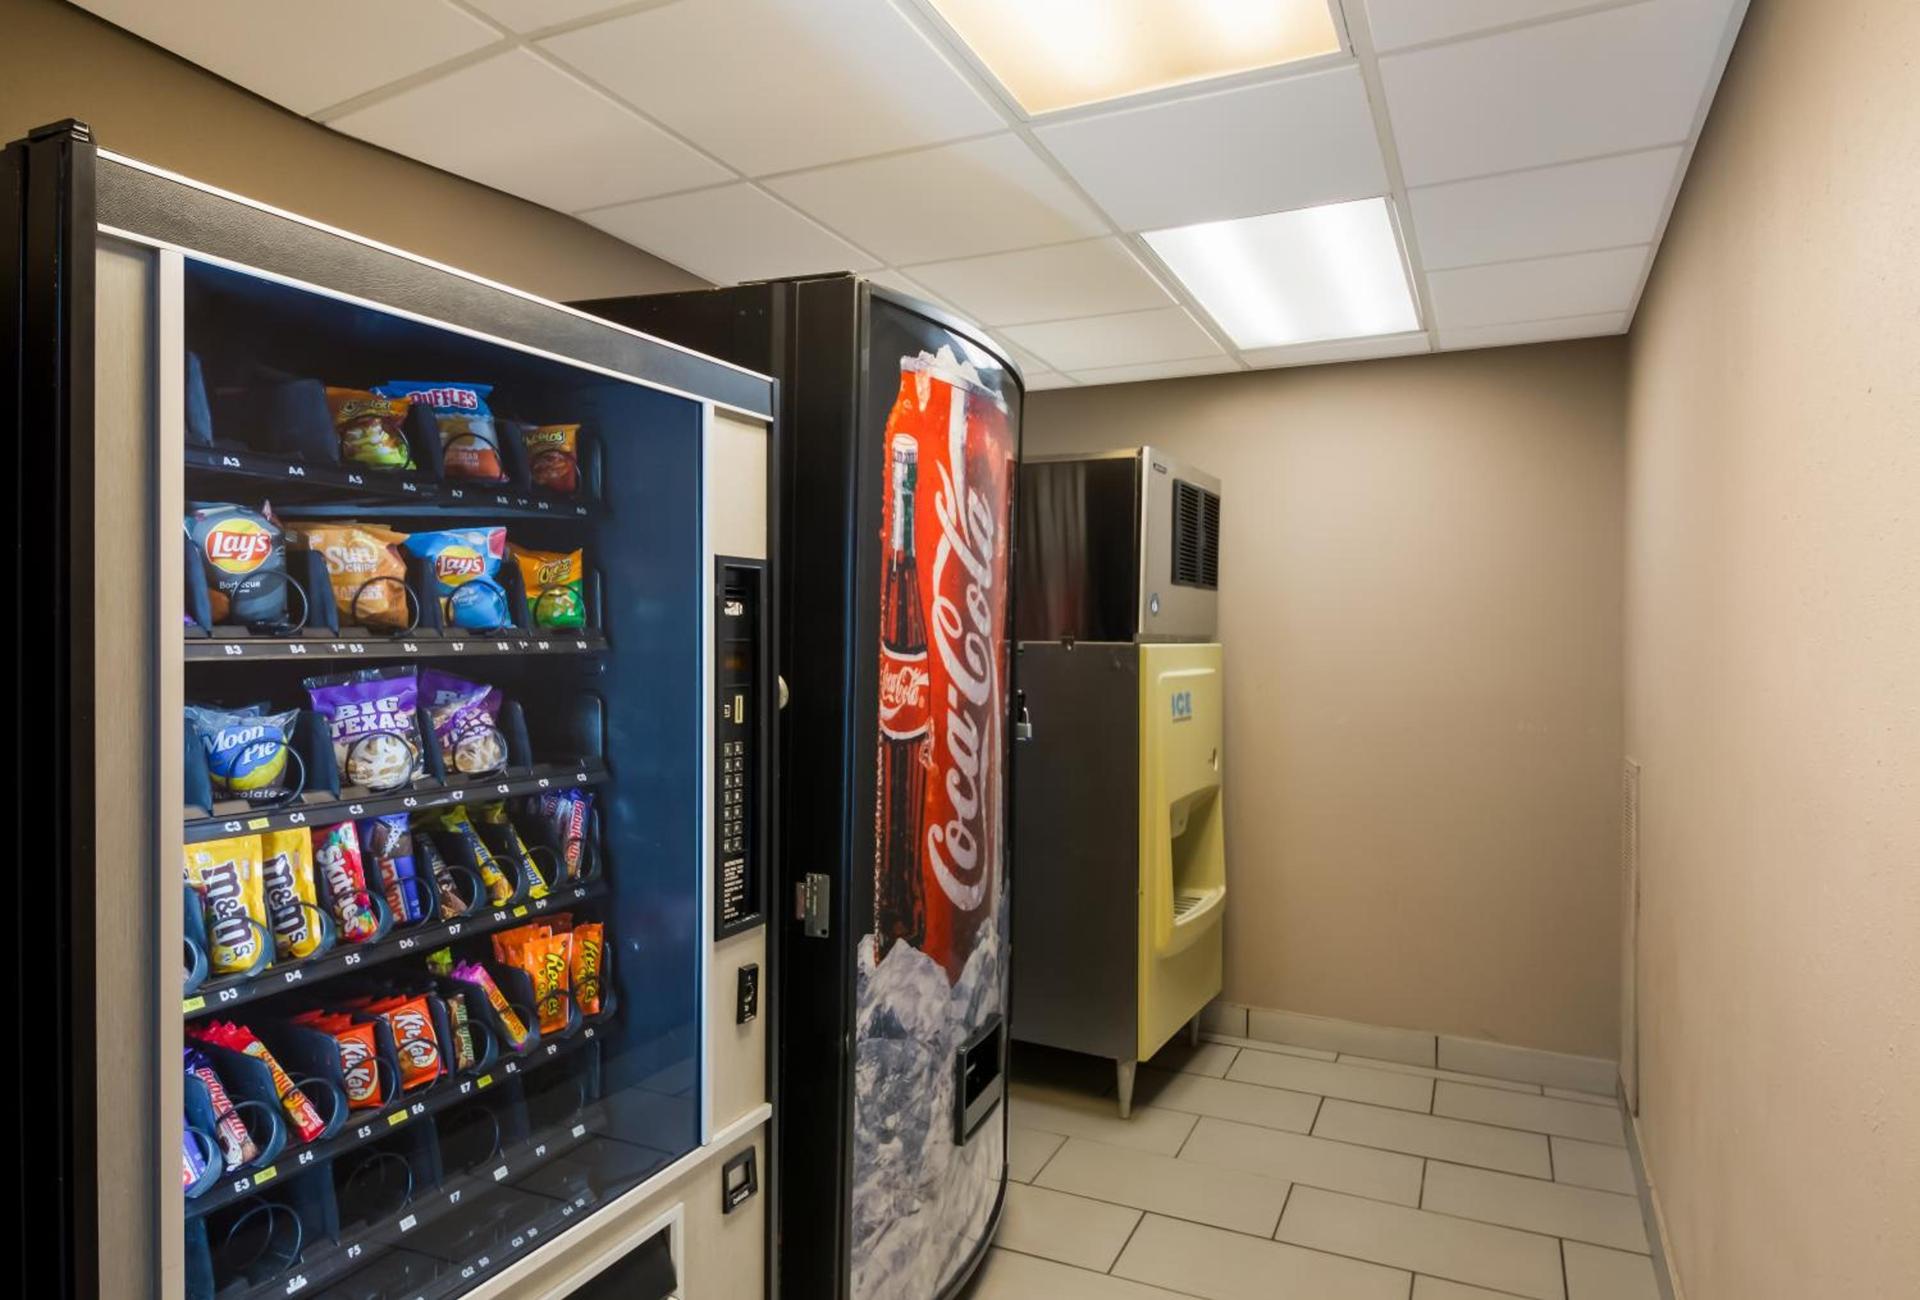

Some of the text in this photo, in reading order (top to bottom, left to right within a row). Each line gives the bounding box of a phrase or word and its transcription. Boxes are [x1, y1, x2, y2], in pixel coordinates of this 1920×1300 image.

[222, 456, 241, 468] A3
[288, 465, 305, 476] A4
[348, 474, 363, 485] A5
[210, 531, 270, 561] Lay's
[224, 644, 243, 655] B3
[289, 644, 307, 654] B4
[349, 643, 365, 653] B5
[403, 643, 418, 653] B6
[451, 642, 464, 652] B7
[927, 459, 996, 912] Coca-Cola
[335, 694, 400, 720] BIG
[1171, 691, 1193, 717] ICE
[330, 712, 410, 739] TEXAS
[202, 725, 266, 754] Moon
[242, 741, 276, 765] Pie
[451, 790, 464, 801] C7
[403, 797, 418, 808] C6
[348, 804, 364, 815] C5
[289, 812, 306, 824] C4
[224, 820, 243, 833] C3
[493, 911, 507, 922] D8
[448, 923, 461, 935] D7
[398, 937, 415, 950] D6
[344, 952, 361, 966] D5
[284, 969, 303, 983] D4
[218, 987, 239, 1002] D3
[546, 1044, 557, 1055] E9
[459, 1080, 471, 1094] E7
[411, 1102, 425, 1115] E6
[357, 1125, 372, 1139] E5
[298, 1150, 314, 1165] E4
[233, 1177, 251, 1193] E3
[449, 1190, 461, 1204] F7
[347, 1243, 362, 1259] F5
